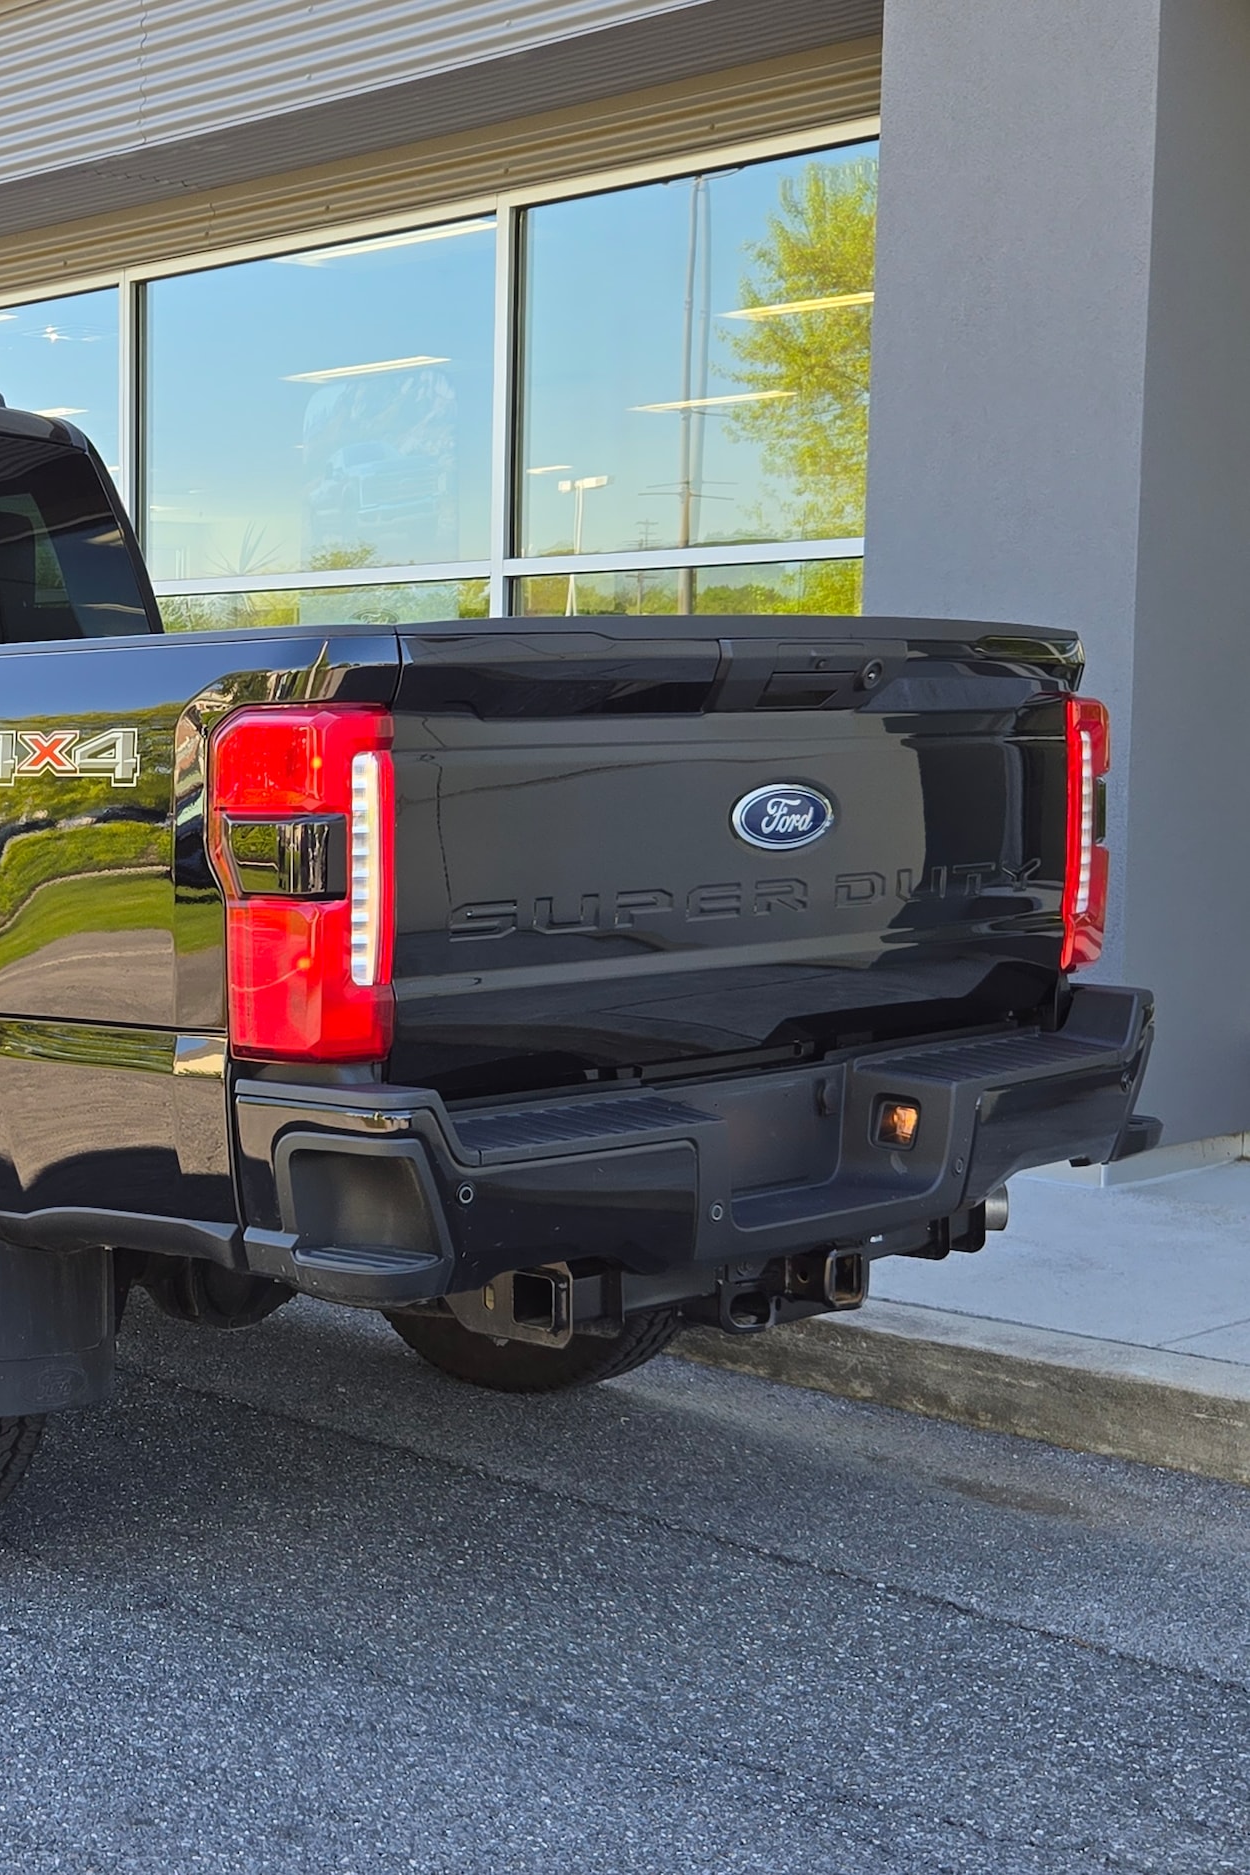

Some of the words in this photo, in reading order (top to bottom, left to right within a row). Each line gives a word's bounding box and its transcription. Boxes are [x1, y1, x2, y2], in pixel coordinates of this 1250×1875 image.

[761, 798, 815, 834] Ford
[449, 877, 808, 942] SUPER
[834, 857, 1042, 909] DUTY
